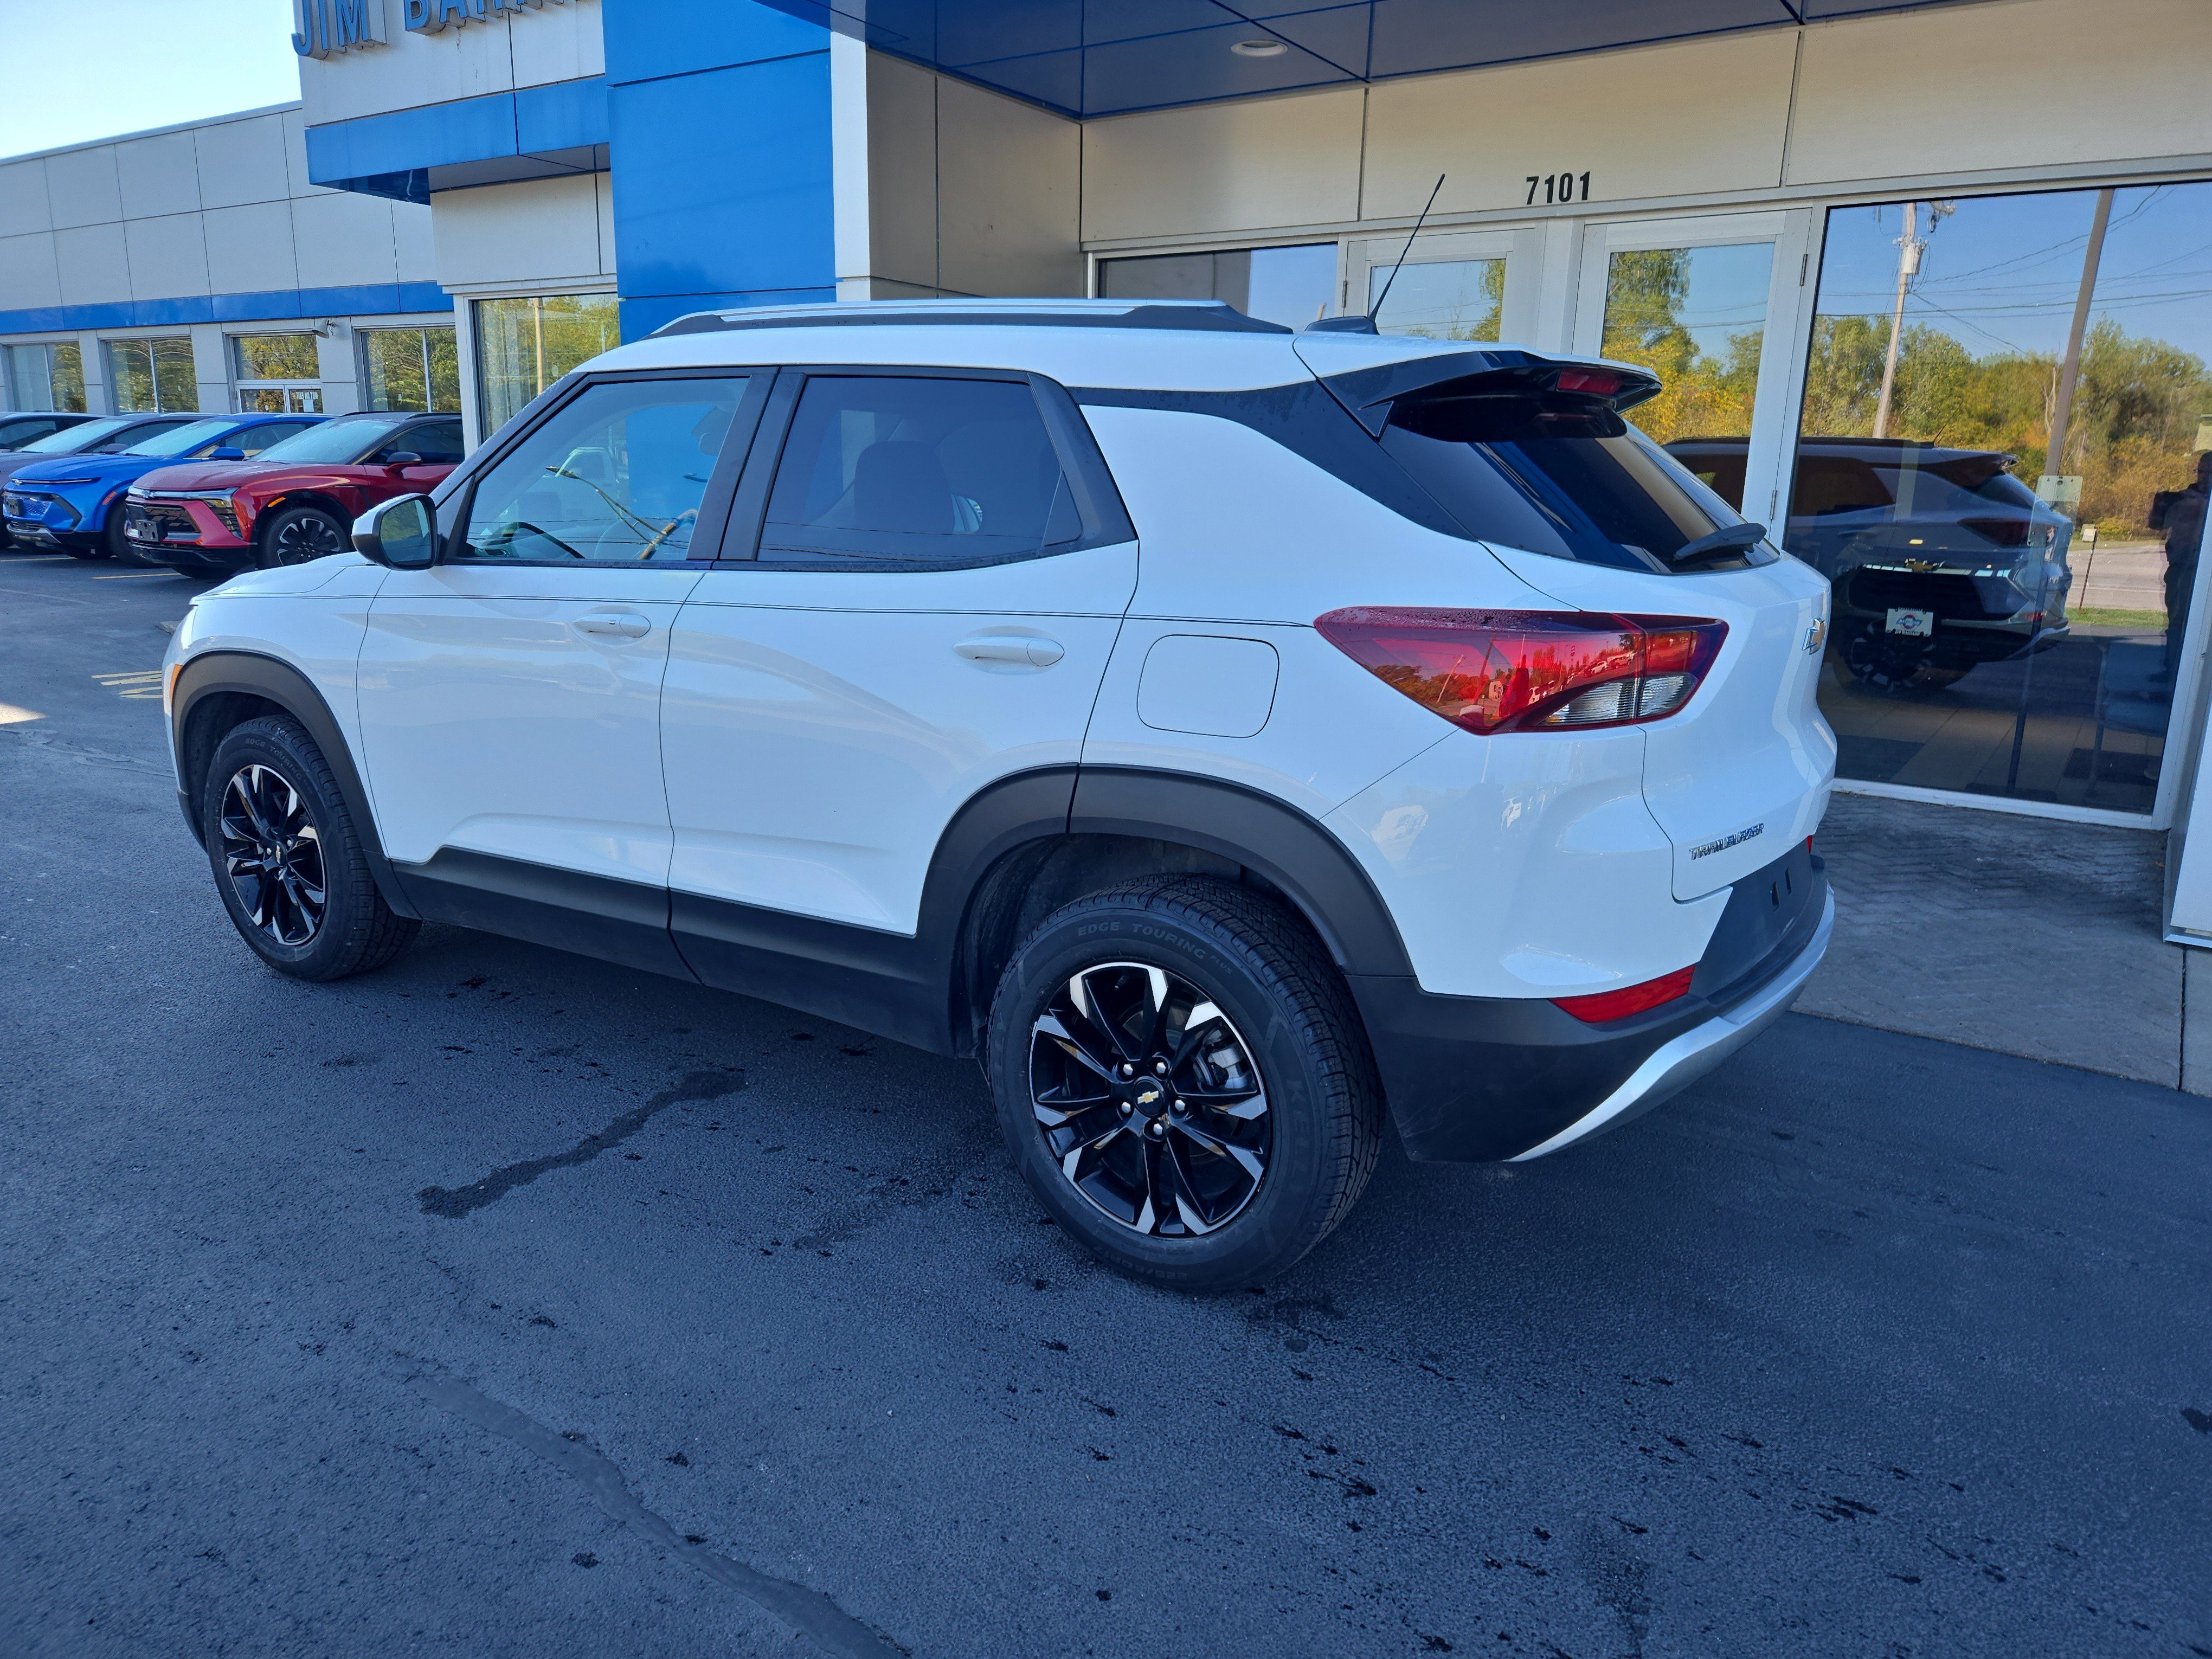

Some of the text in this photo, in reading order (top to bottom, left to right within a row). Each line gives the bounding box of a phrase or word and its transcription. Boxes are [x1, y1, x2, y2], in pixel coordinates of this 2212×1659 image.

[291, 0, 374, 56] JIM
[1526, 171, 1590, 205] 7101
[1689, 822, 1764, 860] TRAILBLAZER
[1077, 922, 1233, 975] EDGE TOURING PLUS
